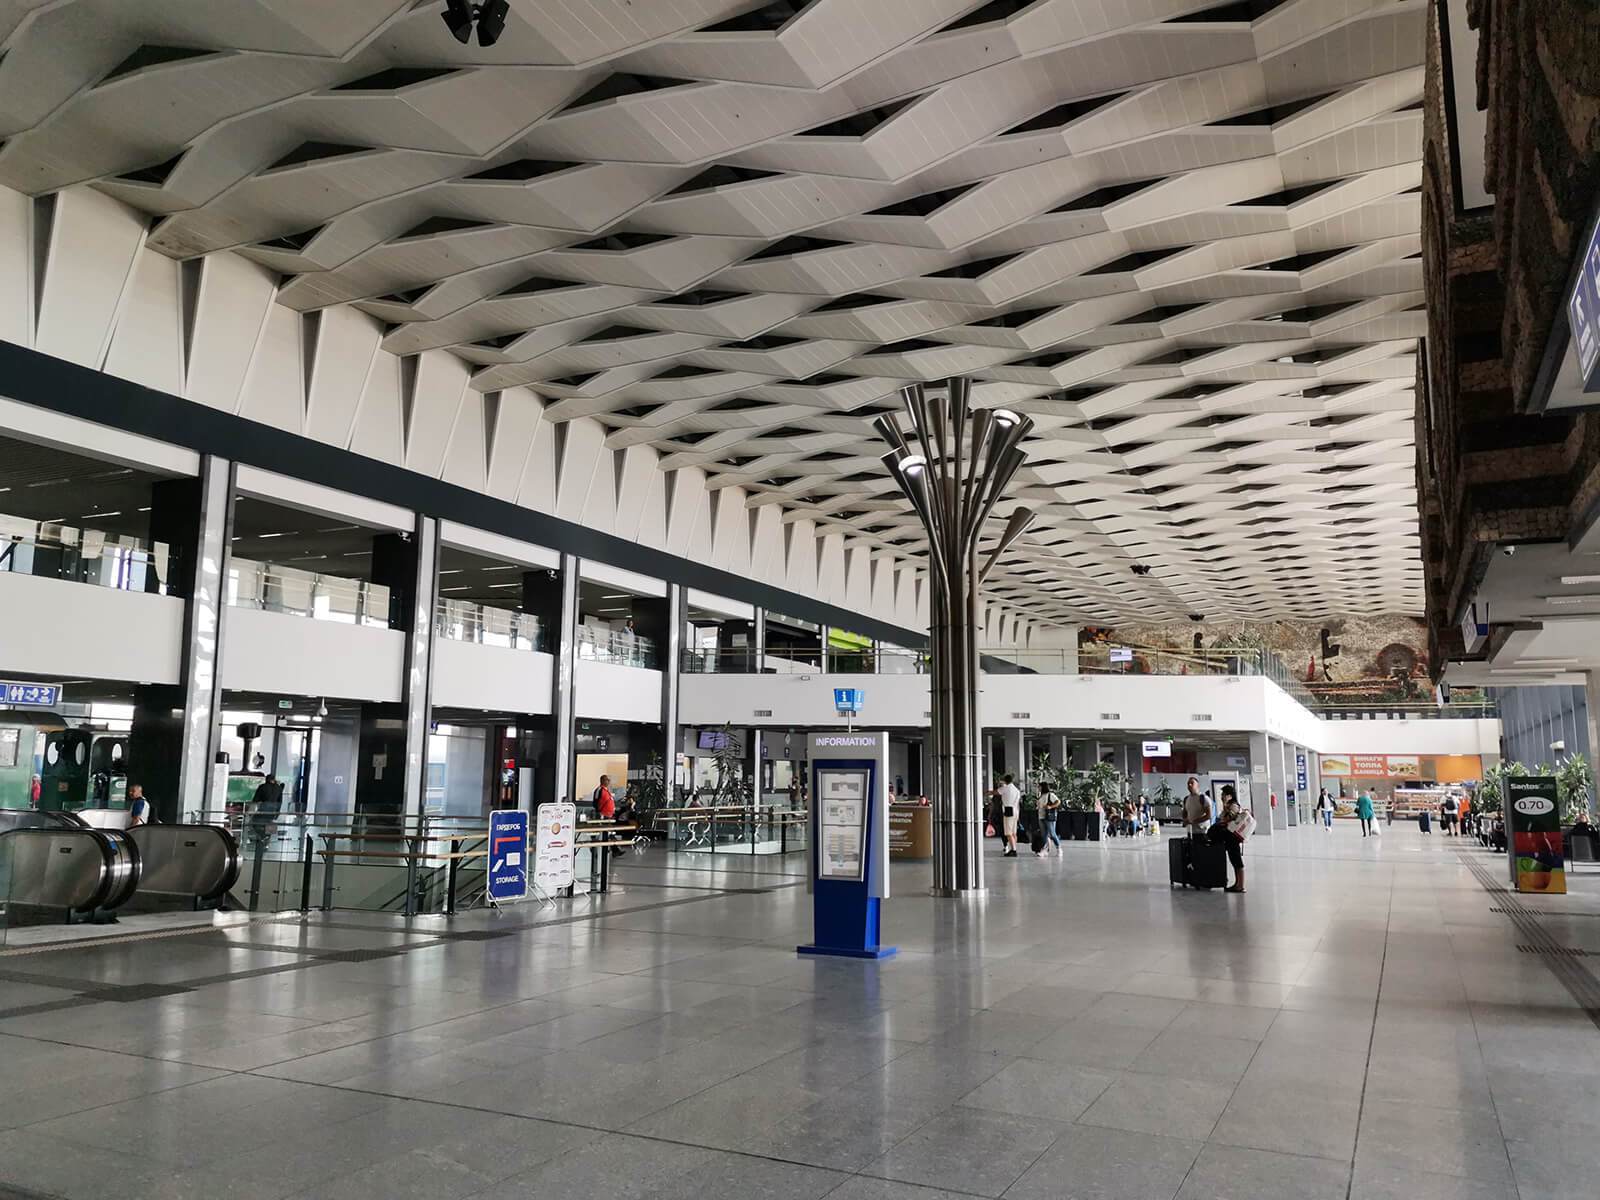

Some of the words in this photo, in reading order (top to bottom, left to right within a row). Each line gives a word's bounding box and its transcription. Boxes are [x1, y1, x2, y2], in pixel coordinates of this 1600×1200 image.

[815, 737, 876, 746] INFORMATION
[1518, 800, 1544, 810] 0.70
[496, 823, 521, 831] ГАРДЕРОБ
[495, 875, 519, 884] STORAGE
